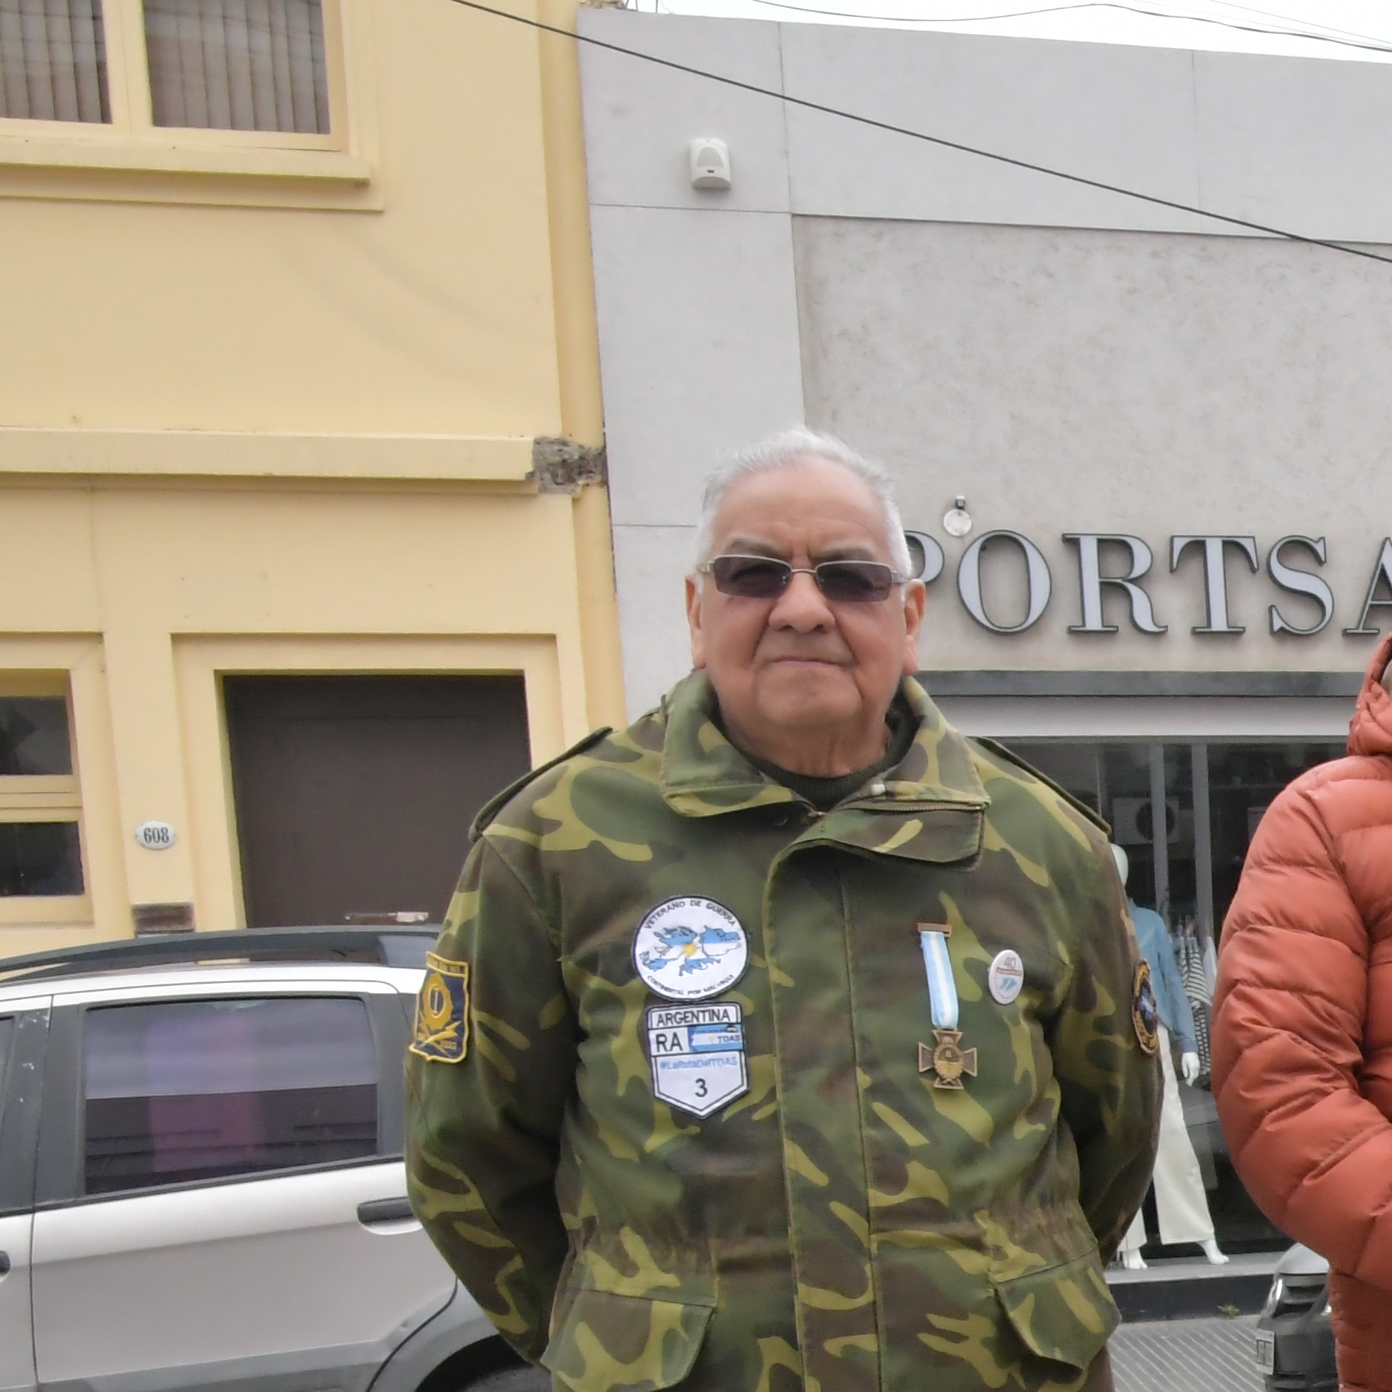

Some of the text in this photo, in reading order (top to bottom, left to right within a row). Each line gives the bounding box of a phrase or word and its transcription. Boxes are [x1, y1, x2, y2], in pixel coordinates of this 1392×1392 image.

[143, 827, 170, 844] 608
[644, 901, 686, 930] VETERANO
[706, 902, 736, 927] GUERRA
[657, 1009, 731, 1027] ARGENTINA
[655, 1032, 683, 1053] RA
[694, 1077, 708, 1098] 3
